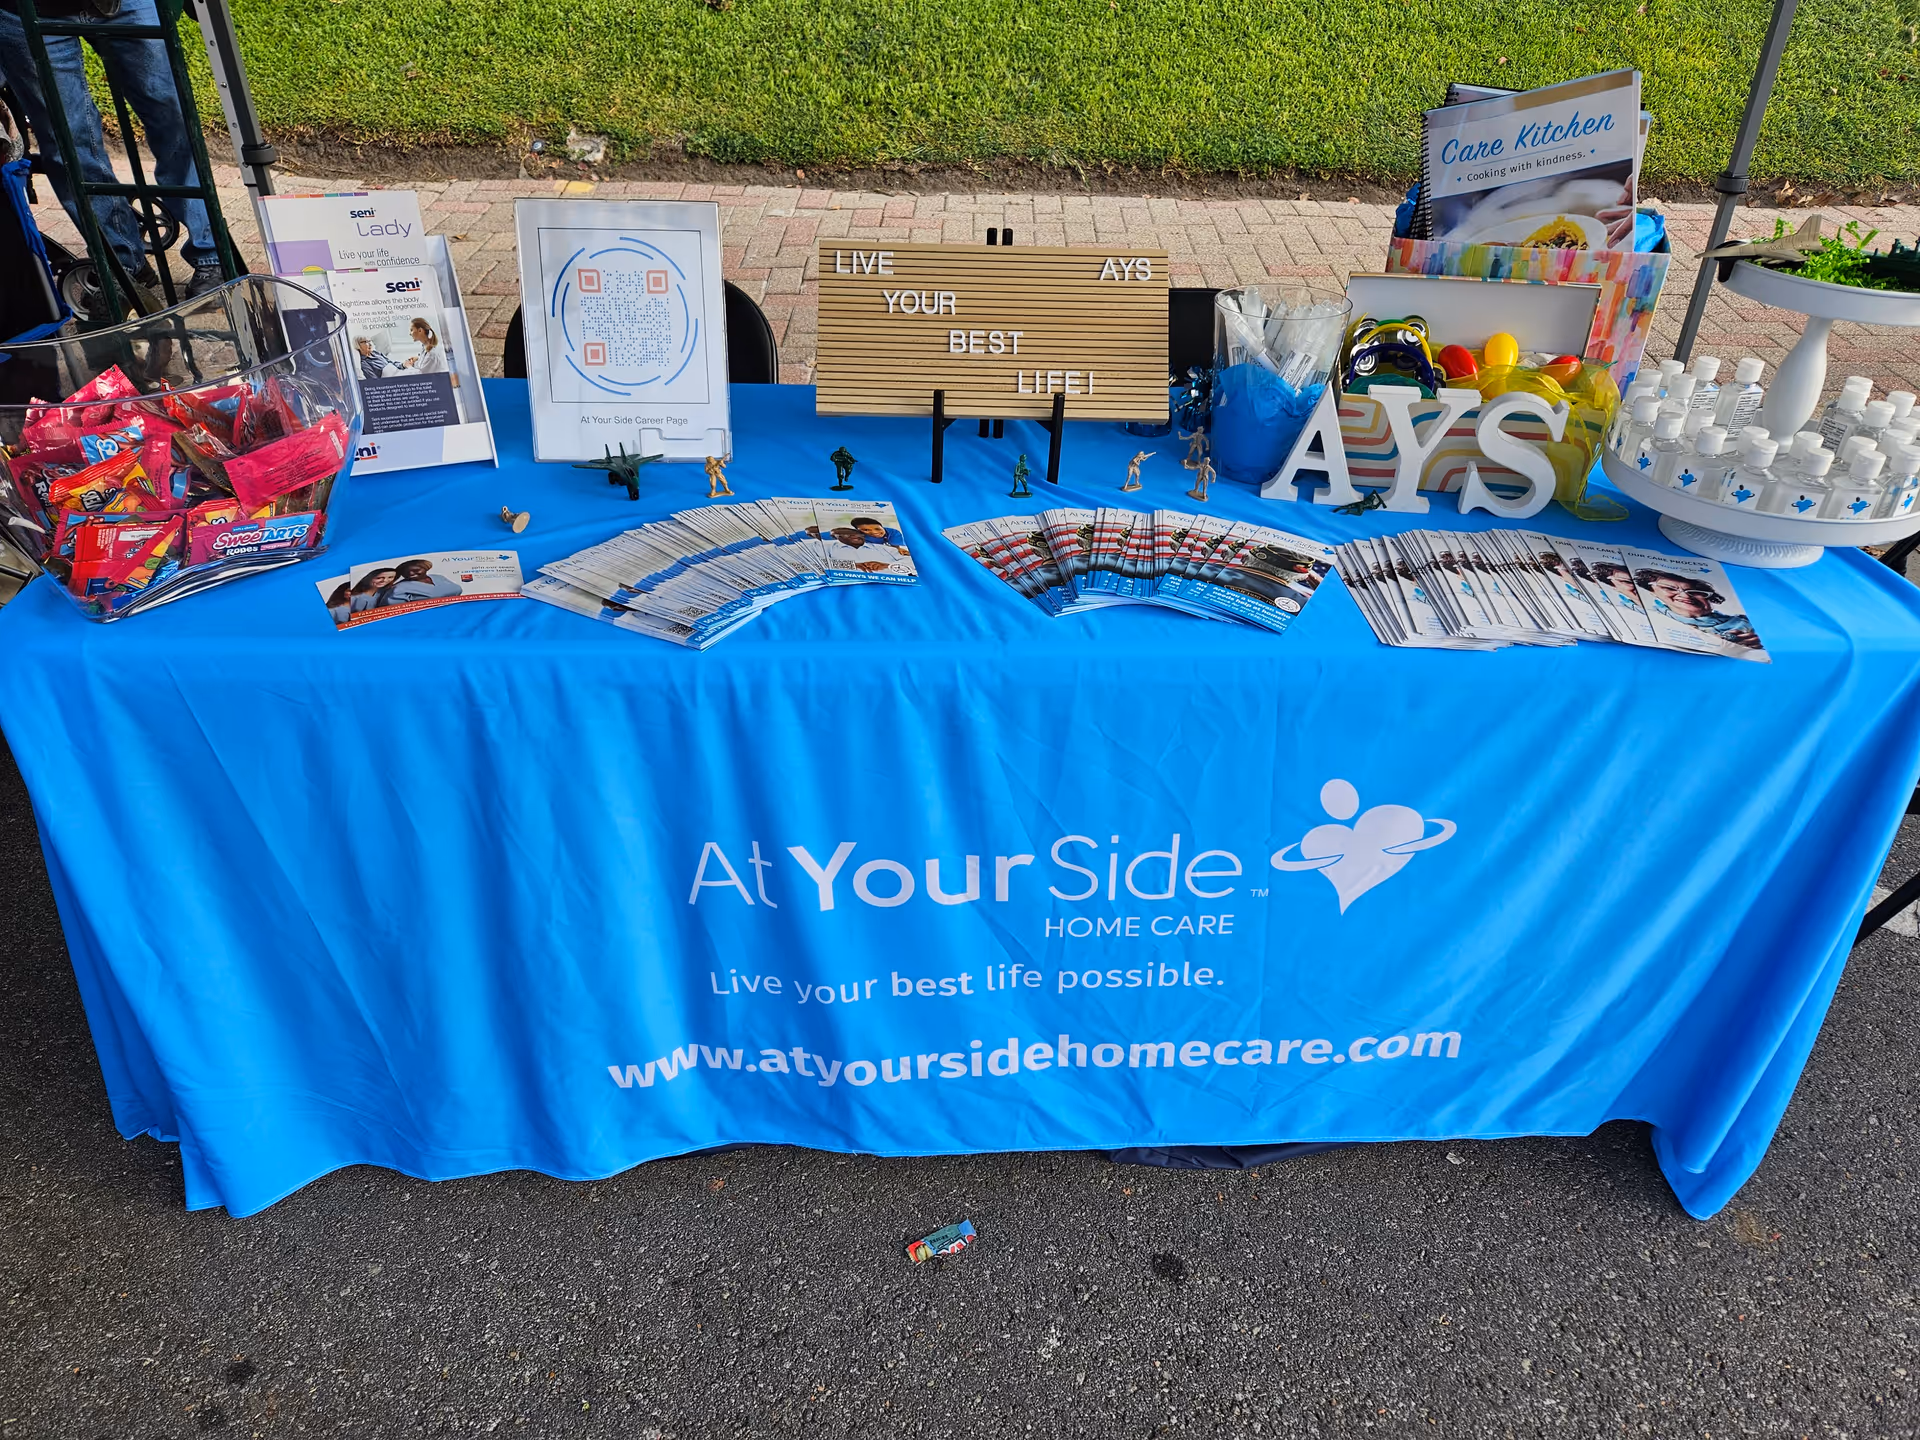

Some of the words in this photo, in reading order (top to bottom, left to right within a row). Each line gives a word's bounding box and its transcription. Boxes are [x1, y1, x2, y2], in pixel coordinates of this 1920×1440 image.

[1441, 138, 1504, 165] Care
[1514, 110, 1615, 151] Kitchen
[1466, 167, 1507, 182] Cooking
[1510, 162, 1532, 173] with
[1536, 151, 1586, 167] kindness.
[350, 207, 376, 219] seni
[356, 218, 412, 238] Lady
[338, 249, 355, 260] Live
[356, 249, 375, 261] your
[376, 248, 389, 258] life
[376, 256, 420, 267] confidence
[835, 250, 894, 276] LIVE
[1099, 258, 1152, 282] AYS
[385, 277, 421, 294] seni
[339, 299, 371, 309] Nighttime
[371, 298, 392, 306] allows
[403, 296, 419, 304] body
[882, 290, 956, 316] YOUR
[949, 329, 1024, 355] BEST
[580, 416, 590, 424] At
[592, 416, 612, 424] Your
[614, 416, 633, 424] Side
[634, 416, 664, 424] Career
[666, 416, 688, 426] Page
[1260, 380, 1570, 519] AYS
[1669, 559, 1709, 567] PROCESS
[846, 572, 867, 580] WAYS
[896, 576, 917, 584] HELP
[1212, 590, 1235, 601] needs
[1236, 598, 1252, 608] help
[1226, 588, 1240, 598] you
[688, 840, 778, 909] At
[786, 841, 1035, 912] Your
[1048, 833, 1243, 901] Side
[1045, 916, 1141, 938] HOME
[1150, 914, 1235, 936] CARE
[710, 968, 782, 995] Live
[794, 974, 878, 1005] your
[890, 970, 975, 996] best
[986, 963, 1043, 991] life
[1058, 961, 1224, 994] possible.
[608, 1030, 1462, 1089] www.atyoursidehomecare.com
